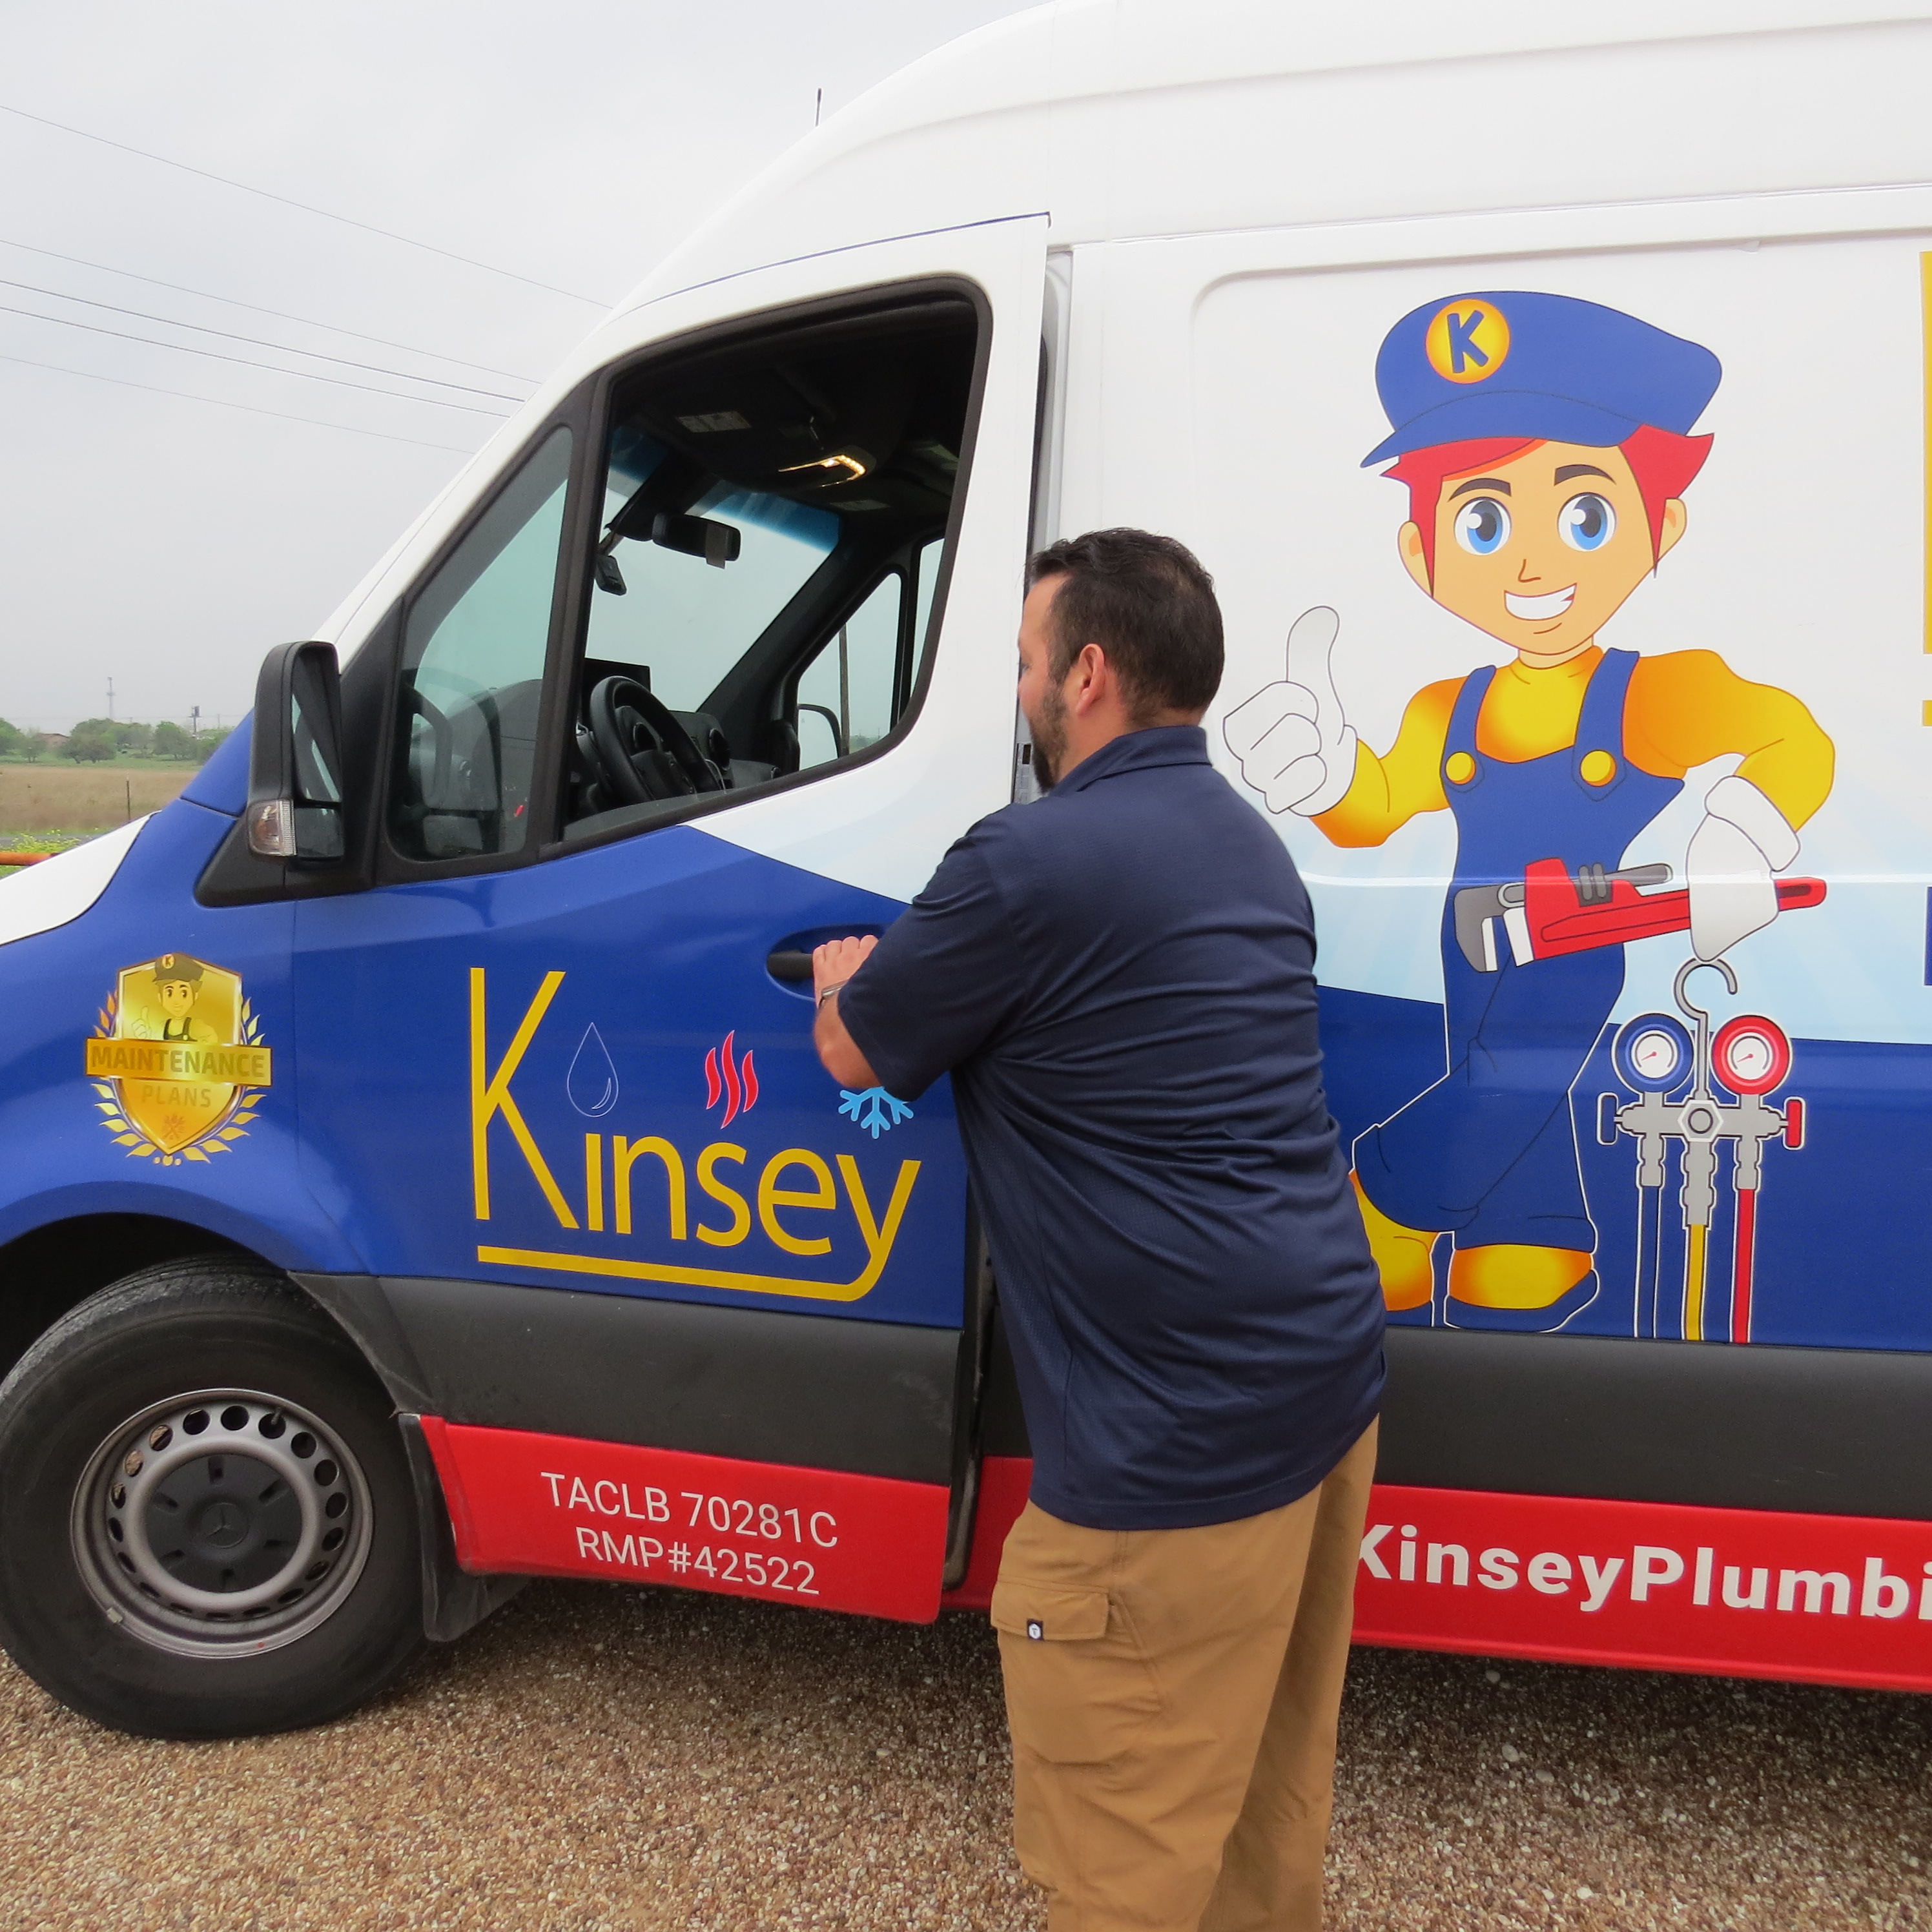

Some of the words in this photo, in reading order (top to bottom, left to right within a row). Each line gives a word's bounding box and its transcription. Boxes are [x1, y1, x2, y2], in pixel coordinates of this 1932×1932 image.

[1447, 310, 1488, 373] K
[91, 1045, 265, 1078] MAINTENANCE
[141, 1085, 211, 1107] PLANS
[470, 967, 921, 1302] Kinsey
[540, 1472, 671, 1523] TACLB
[681, 1492, 838, 1548] 70281C
[576, 1526, 819, 1595] RMP#42522
